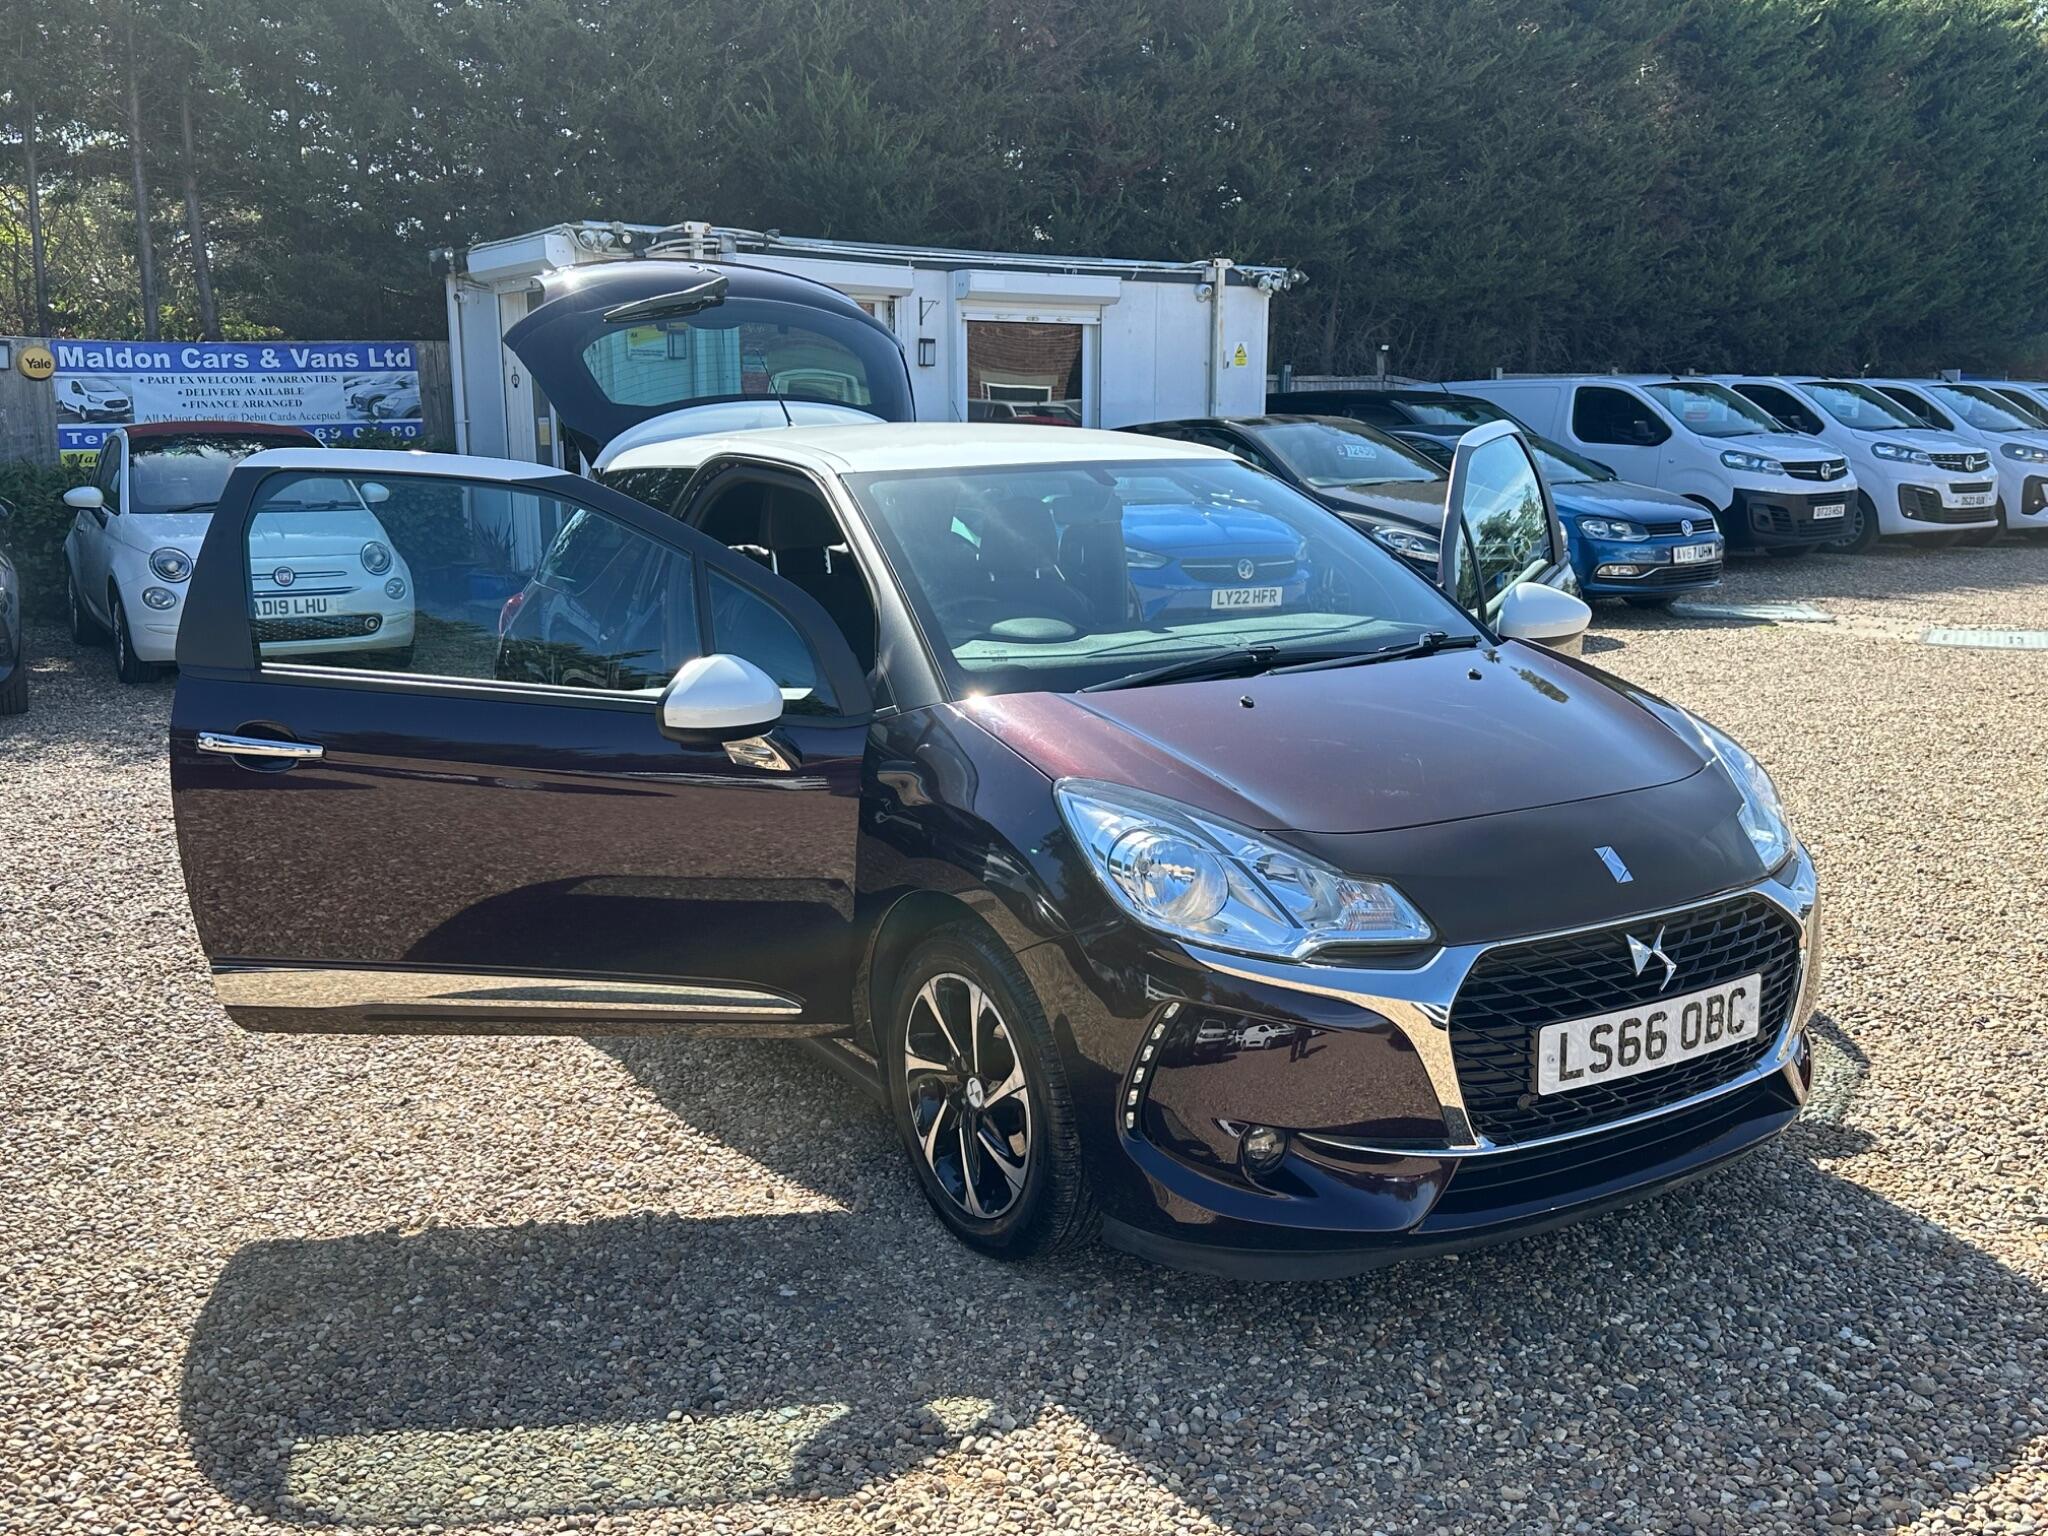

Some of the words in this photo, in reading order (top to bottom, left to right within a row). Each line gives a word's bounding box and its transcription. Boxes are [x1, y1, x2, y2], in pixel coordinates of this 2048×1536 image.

[25, 357, 52, 369] Yale
[57, 345, 171, 369] Maldon
[181, 347, 250, 369] Cars
[259, 348, 281, 369] &
[290, 348, 360, 368] Vans
[368, 348, 412, 368] Ltd
[147, 376, 175, 385] PART
[179, 376, 195, 385] EX
[197, 375, 256, 384] WELCOME
[265, 375, 338, 384] WARRANTIES
[185, 388, 241, 397] DELIVERY
[246, 387, 305, 396] AVAILABLE
[189, 400, 239, 409] FINANCE
[242, 399, 303, 408] ARRANGED
[144, 413, 159, 423] All
[194, 412, 225, 422] Credit
[241, 412, 267, 422] Debit
[269, 411, 297, 421] Cards
[300, 410, 341, 422] Accepted
[314, 427, 341, 439] 69
[1216, 589, 1251, 606] LY22
[1252, 588, 1277, 604] HFR
[294, 598, 327, 614] LHU
[1559, 1010, 1668, 1082] LS66
[1680, 986, 1746, 1050] OBC
